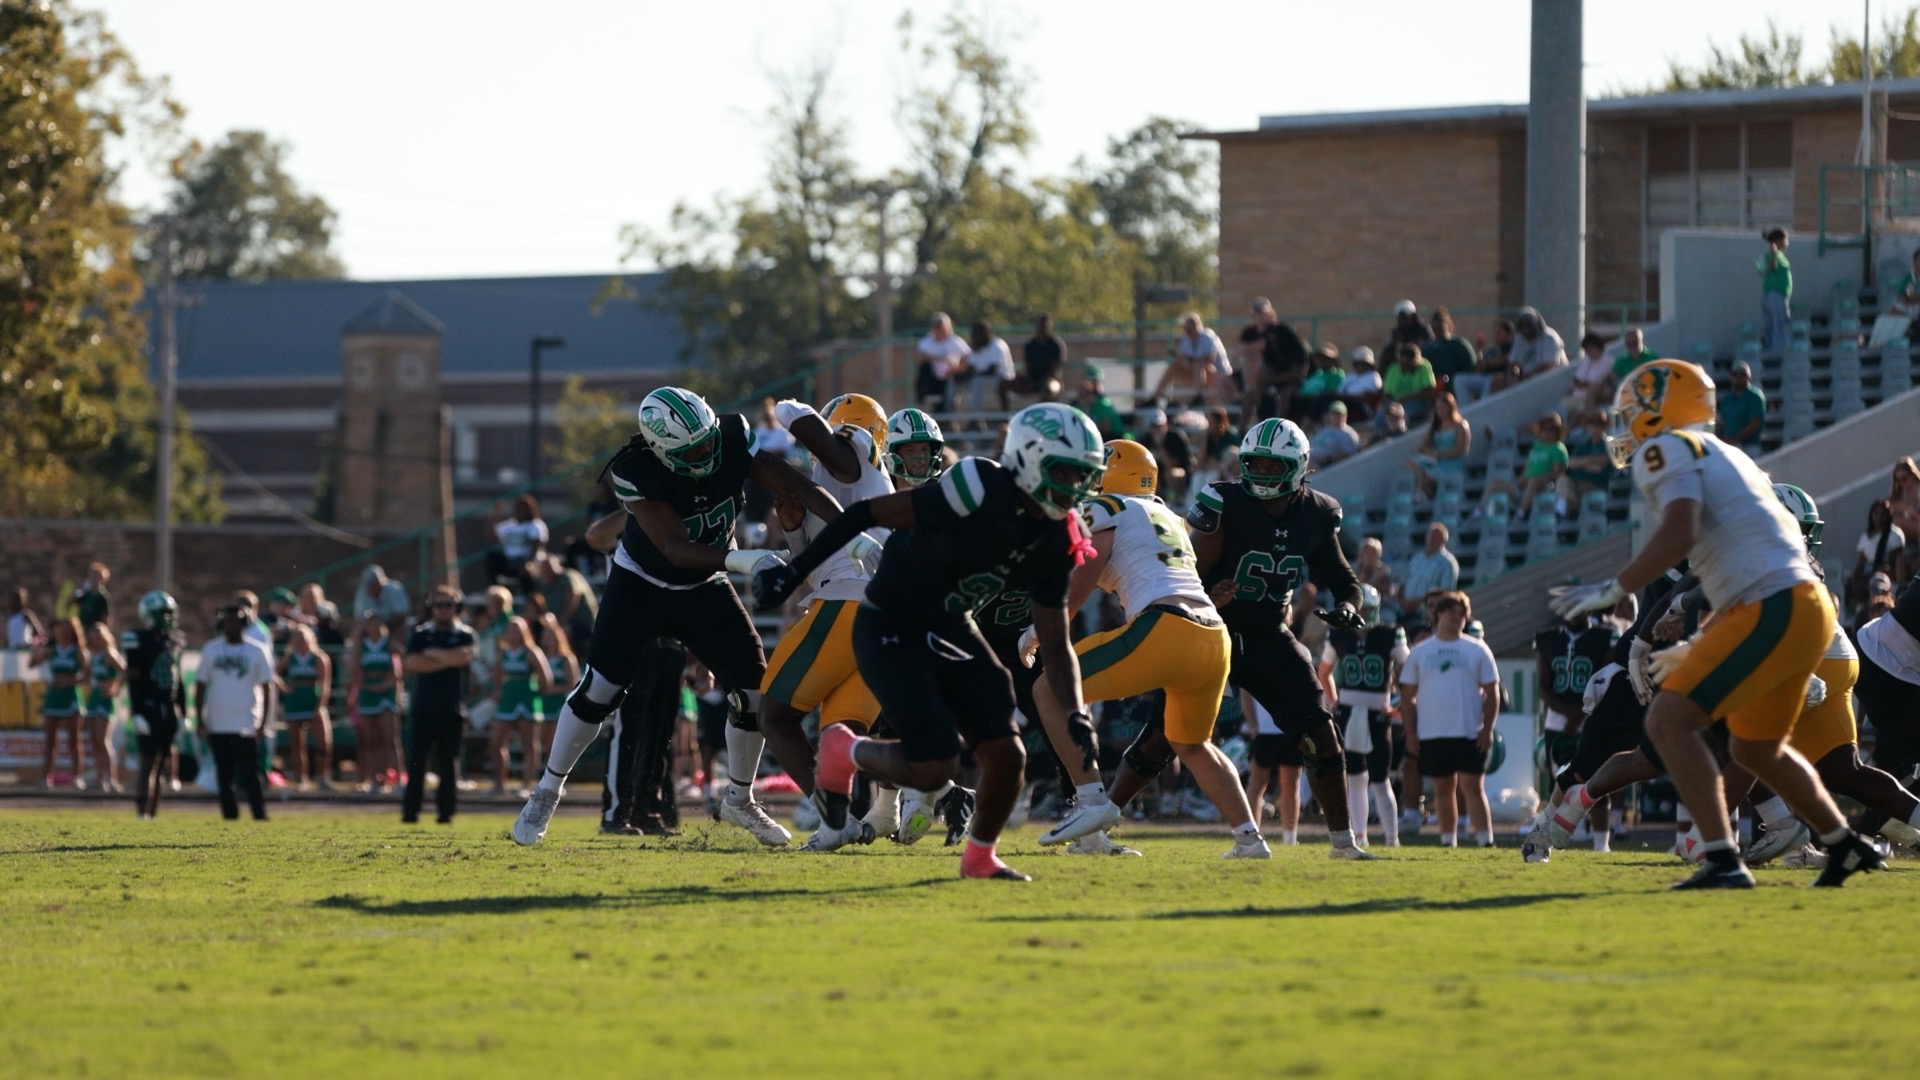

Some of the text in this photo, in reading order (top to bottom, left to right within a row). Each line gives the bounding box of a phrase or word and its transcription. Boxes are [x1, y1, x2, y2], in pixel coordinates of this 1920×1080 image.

[1643, 444, 1666, 474] 9
[1140, 477, 1152, 488] 95
[1232, 550, 1305, 602] 63
